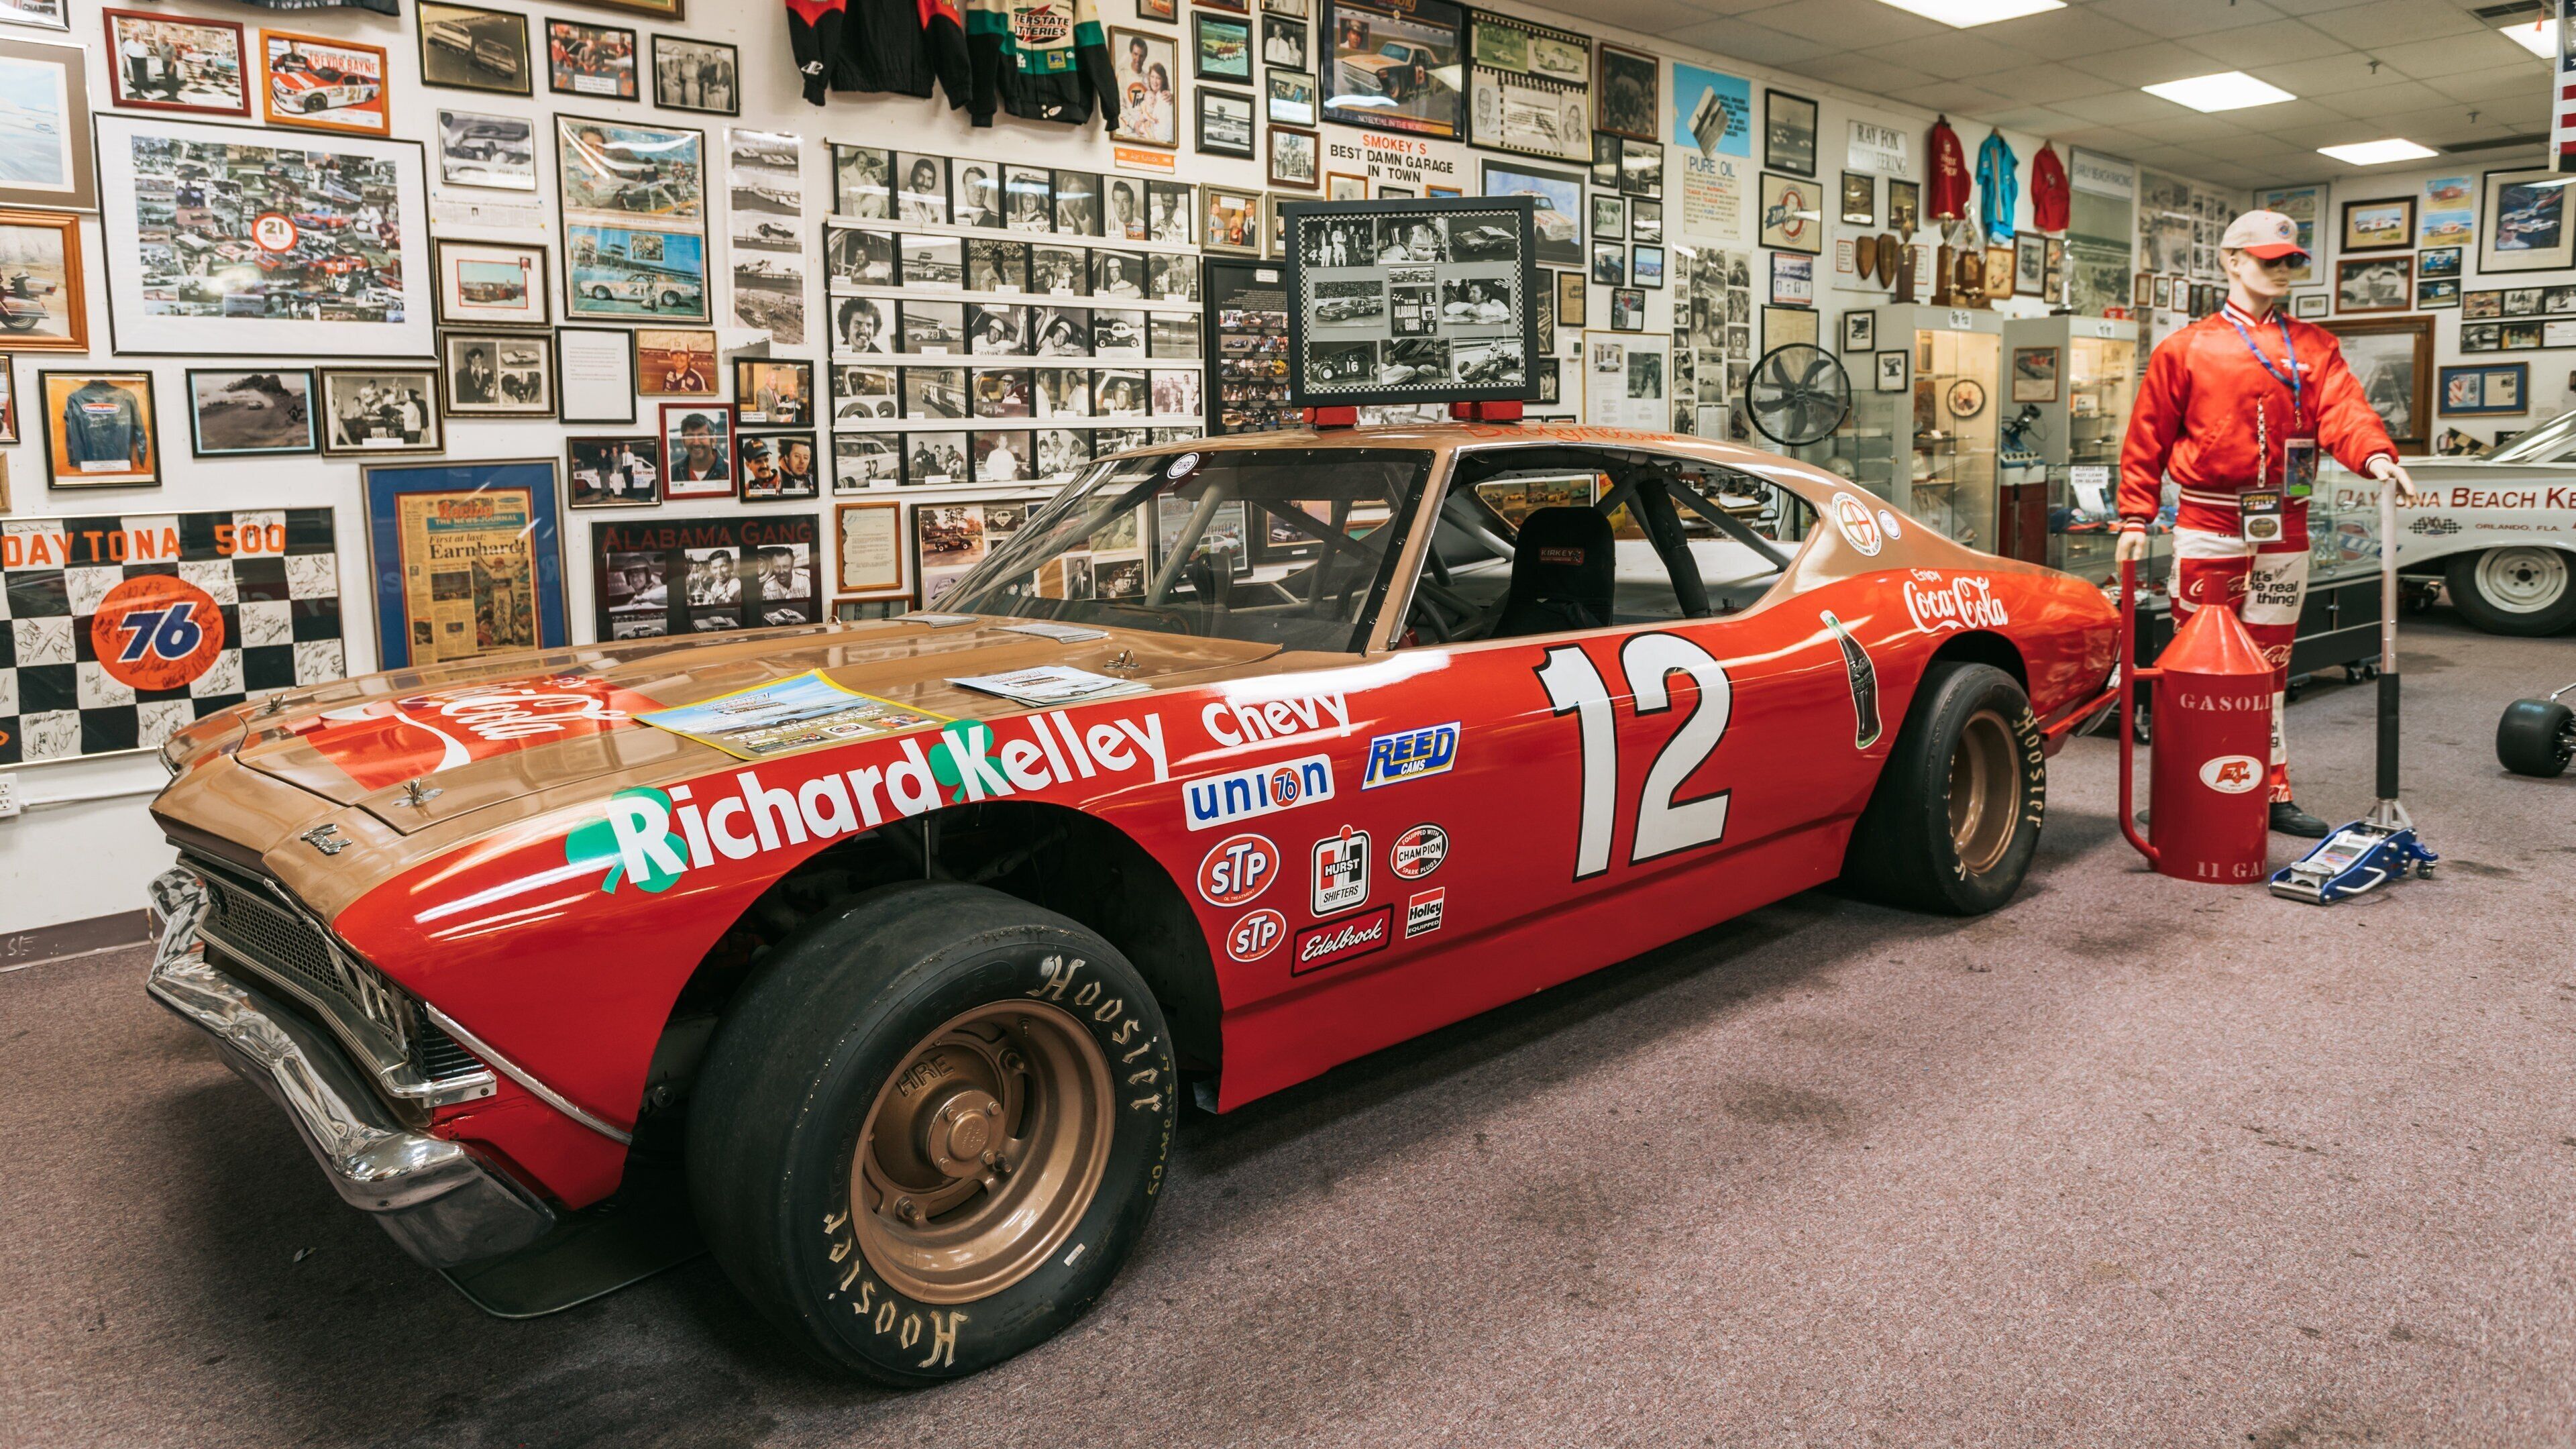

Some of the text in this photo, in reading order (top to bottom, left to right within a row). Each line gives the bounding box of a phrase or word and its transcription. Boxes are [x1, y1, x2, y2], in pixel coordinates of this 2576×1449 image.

[1014, 14, 1070, 26] TERSTATE
[1014, 27, 1067, 37] TTERIES
[309, 53, 344, 70] TREVOR
[347, 58, 376, 74] BAYNE
[1368, 117, 1388, 126] EQUAL
[1362, 134, 1427, 155] SMOKEY S
[1856, 123, 1899, 150] RAY FOX
[1330, 144, 1454, 174] BEST DAMN GARAGE
[1689, 156, 1736, 177] PURE OIL
[1367, 164, 1421, 182] IN TOWN
[264, 221, 284, 235] 21
[1395, 305, 1419, 318] ALABAMA
[1405, 318, 1419, 331] GANG
[1346, 362, 1358, 372] 16
[1176, 460, 1192, 470] PURE
[2451, 488, 2536, 508] BEACH
[2546, 487, 2576, 509] KE
[602, 521, 813, 552] ALABAMA GANG
[2475, 523, 2532, 531] ORLANDO,
[1, 524, 286, 567] DAYTONA 500
[429, 533, 487, 544] First at last:
[430, 539, 527, 559] Earnhardt
[1911, 568, 1943, 582] Enjoy
[2251, 570, 2273, 582] it's
[2269, 580, 2298, 592] real
[1903, 576, 2008, 633] Coca-Cola
[2257, 591, 2298, 608] thing!
[117, 601, 203, 663] 76
[2180, 693, 2273, 712] GASOLI
[1366, 727, 1458, 782] REED
[1534, 631, 1733, 883] 12
[1401, 759, 1426, 775] CAMS
[2012, 706, 2045, 829] Hoosier
[604, 711, 1169, 885] Richard Kelley
[1274, 775, 1297, 803] 76
[1401, 828, 1440, 845] EQUIPPED WITH
[1398, 843, 1442, 862] CHAMPION
[1211, 843, 1267, 895] STP
[1325, 858, 1360, 876] HURST
[1402, 859, 1438, 875] SPARK PLUGS
[2197, 859, 2266, 878] 11 GA
[1230, 889, 1255, 900] TREATMENT
[1324, 885, 1358, 904] SHIFTERS
[1409, 902, 1442, 921] Holley
[1236, 915, 1277, 954] STP
[1408, 920, 1440, 933] EQUIPPED
[1301, 918, 1383, 962] Edelbrock
[1026, 955, 1163, 1113] Hoosier
[896, 1053, 955, 1097] HRE
[823, 1208, 969, 1369] Hoosier
